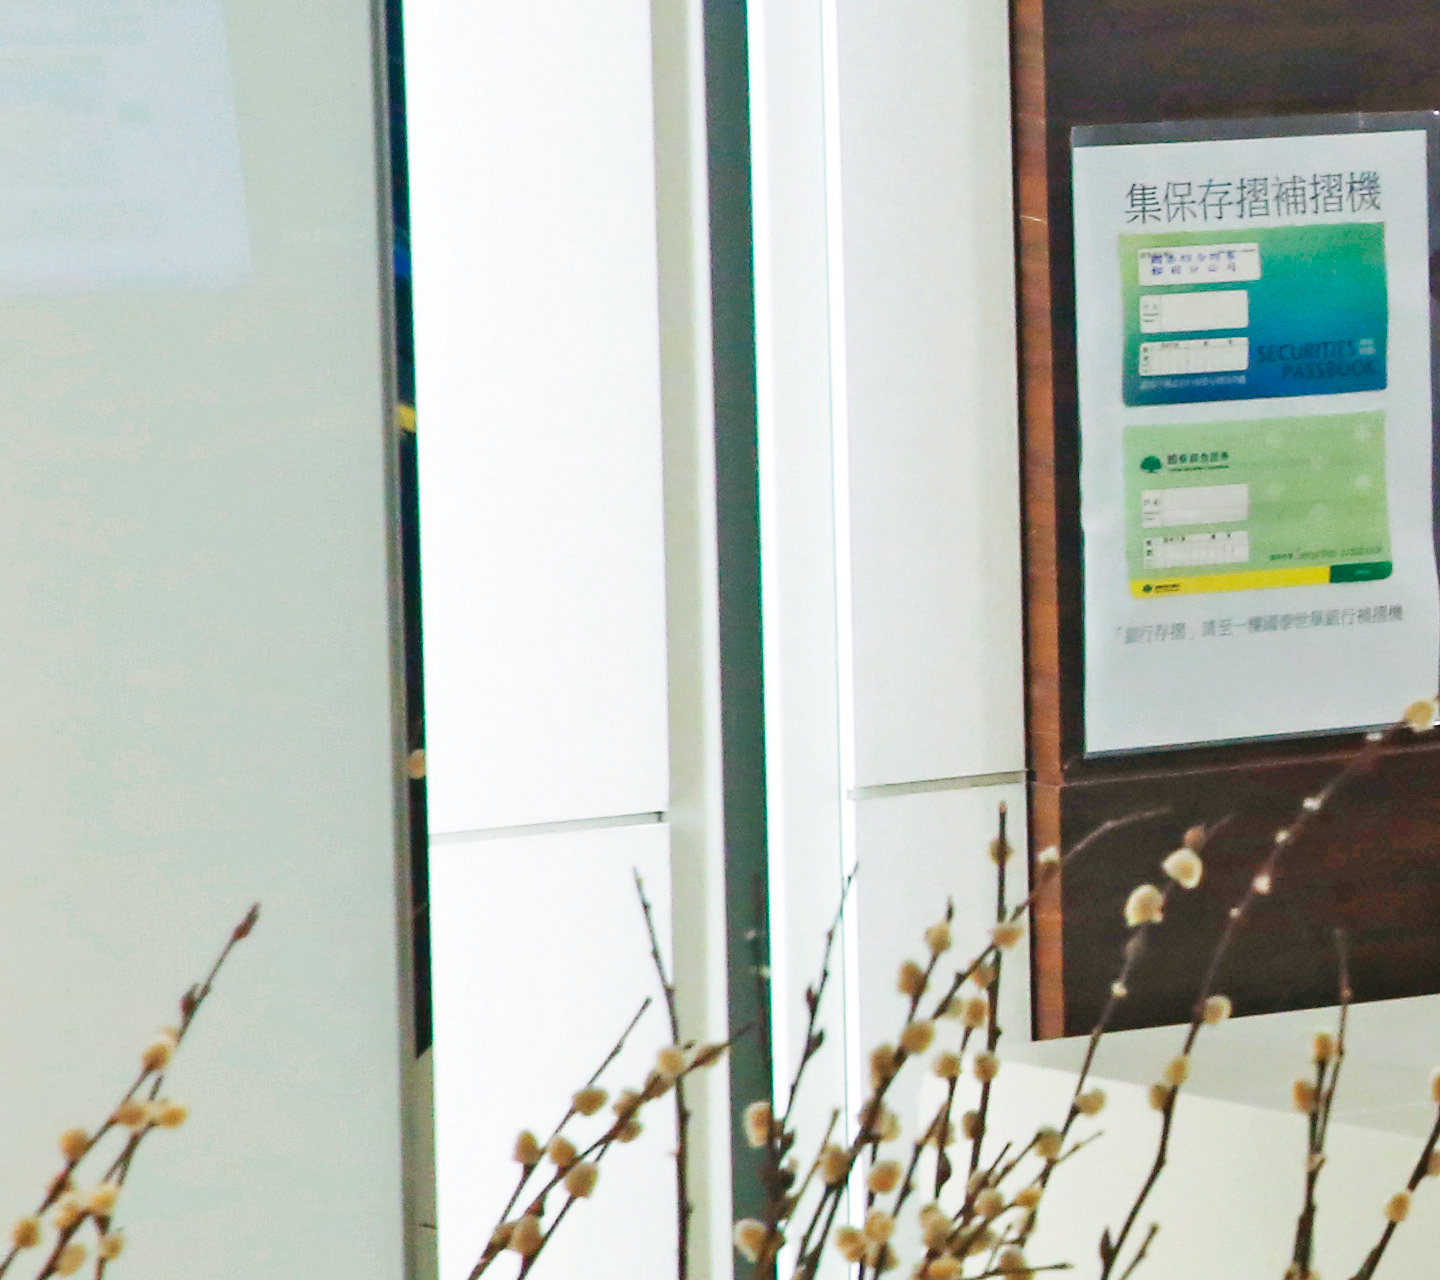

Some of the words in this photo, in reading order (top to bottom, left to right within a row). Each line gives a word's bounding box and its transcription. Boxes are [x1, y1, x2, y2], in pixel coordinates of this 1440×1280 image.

[1124, 171, 1382, 224] 集保存摺補摺機
